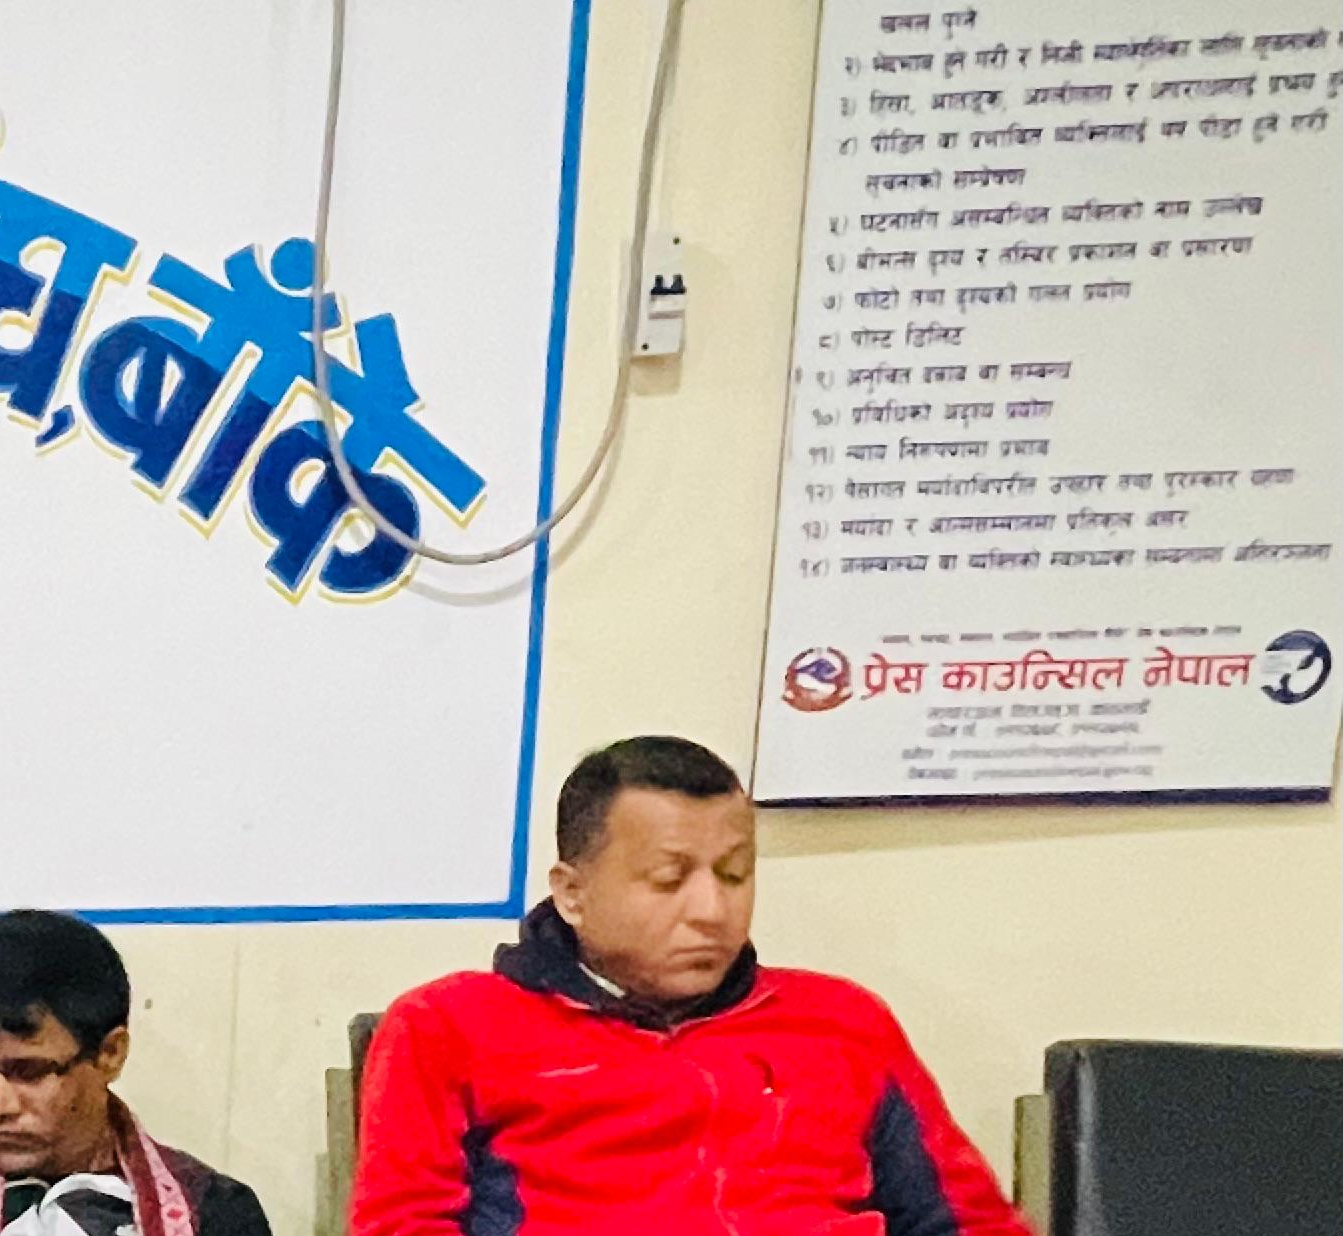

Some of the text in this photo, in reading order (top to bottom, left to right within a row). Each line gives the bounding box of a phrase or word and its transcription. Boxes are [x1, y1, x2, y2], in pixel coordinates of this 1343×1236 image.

[860, 646, 1258, 701] प्रेस काउन्सिल नेपाल
